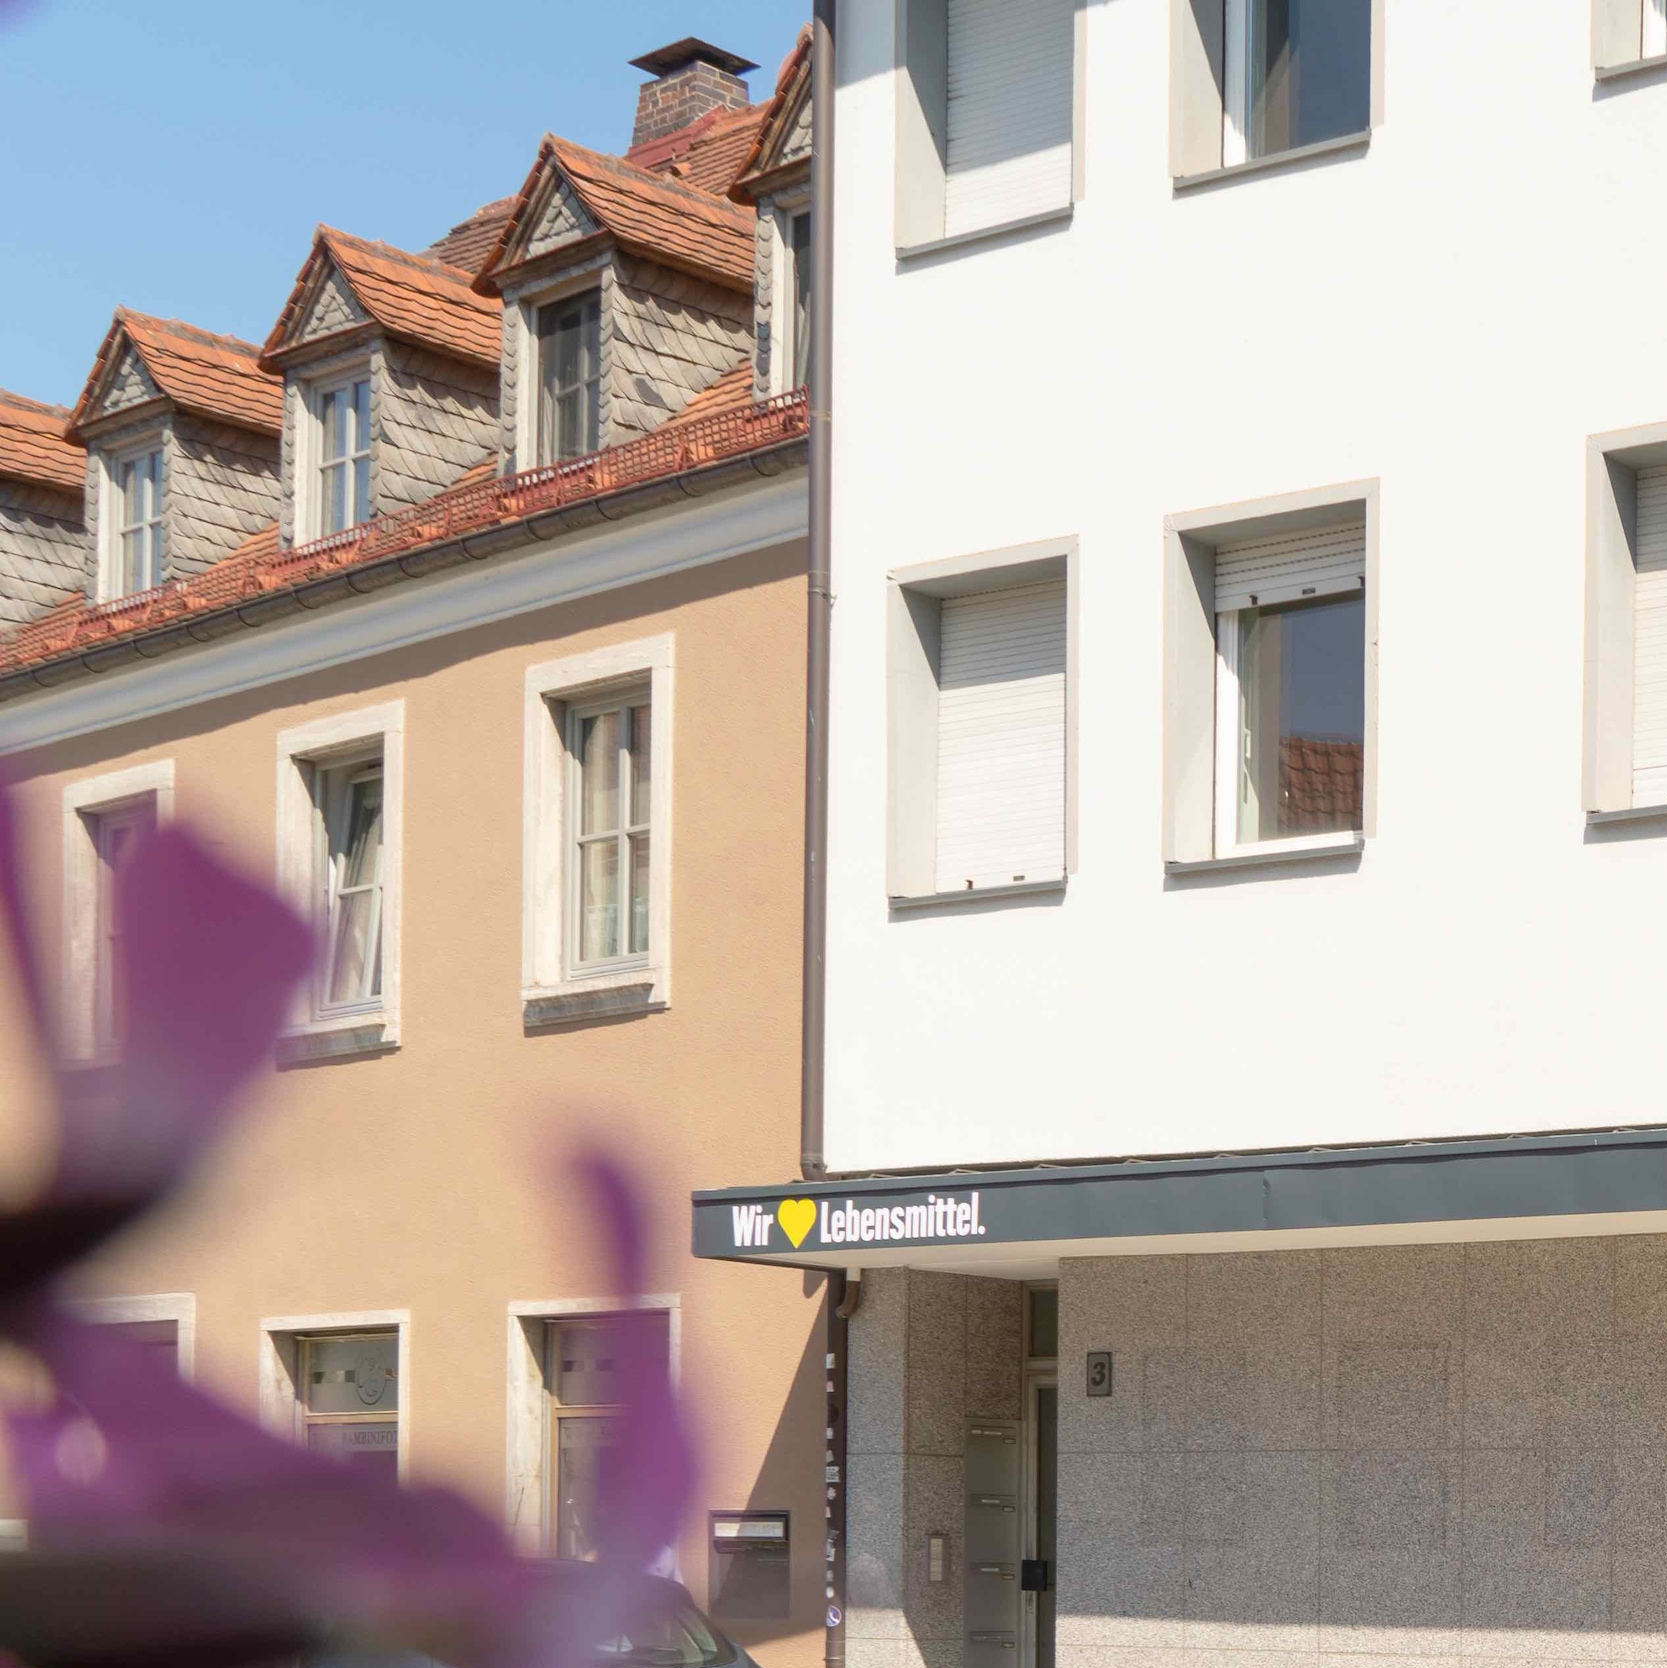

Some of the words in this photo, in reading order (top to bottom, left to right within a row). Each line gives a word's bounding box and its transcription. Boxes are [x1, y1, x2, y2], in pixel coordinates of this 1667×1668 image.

[732, 1205, 774, 1247] Wir
[820, 1191, 986, 1244] Lebensmittel.
[1091, 1361, 1106, 1386] 3
